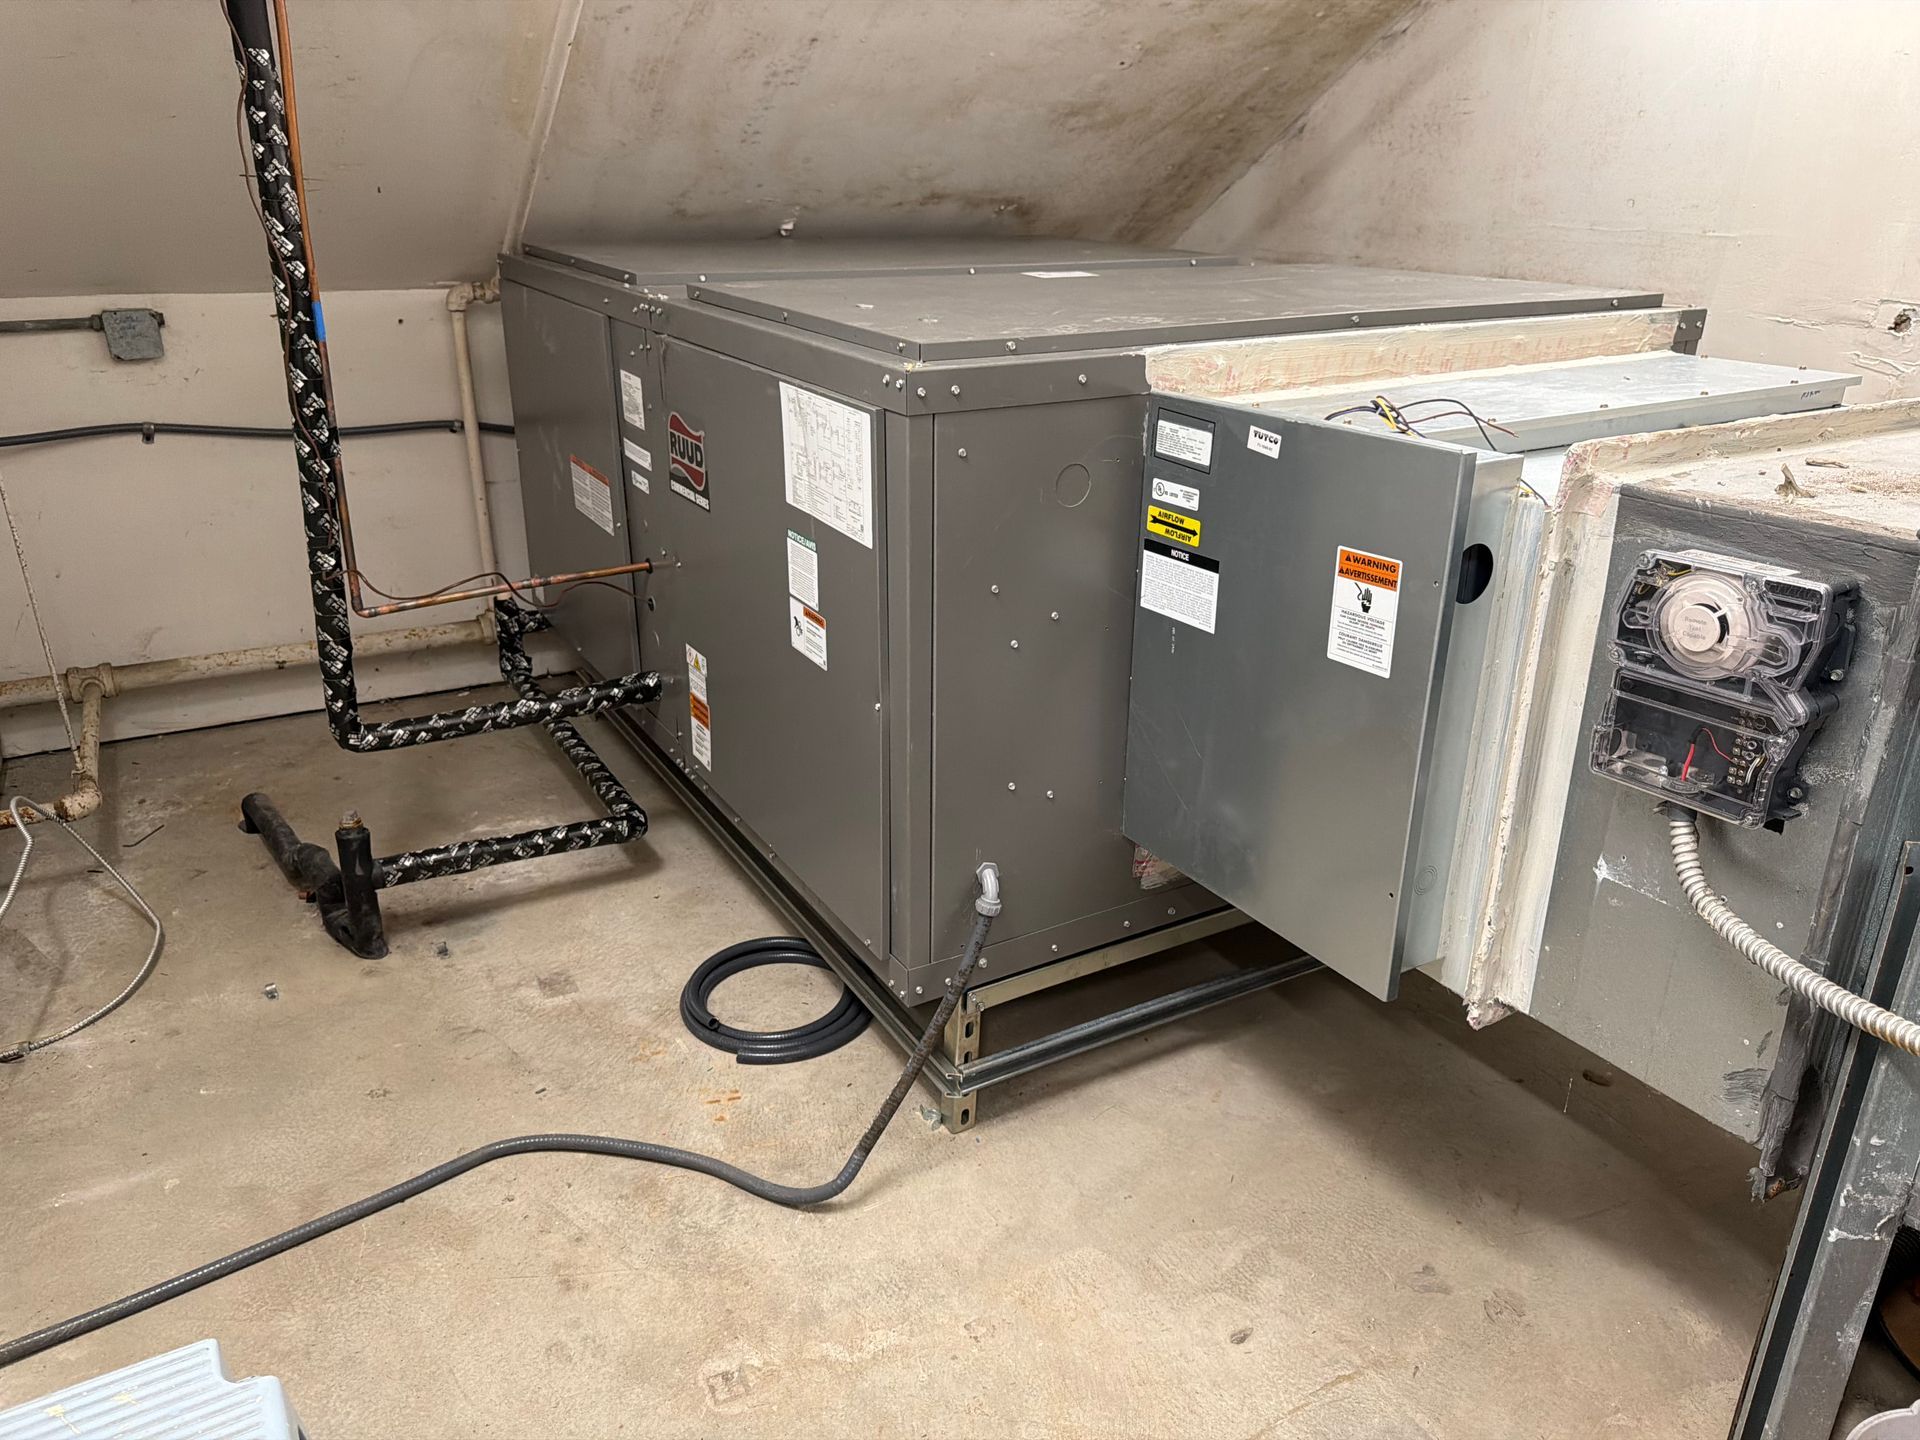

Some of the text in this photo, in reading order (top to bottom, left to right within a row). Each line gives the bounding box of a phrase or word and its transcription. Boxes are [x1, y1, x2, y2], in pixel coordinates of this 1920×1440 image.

[1253, 429, 1279, 445] TUTCO
[670, 431, 704, 469] RUUD
[1158, 511, 1185, 525] AIRFLOW
[1165, 528, 1192, 542] AIRFLOW
[1171, 548, 1190, 561] NOTICE
[1353, 555, 1396, 573] WARNING
[1345, 568, 1397, 588] AVERTISSEMENT
[1685, 616, 1706, 625] Remote
[1683, 631, 1706, 640] Capable
